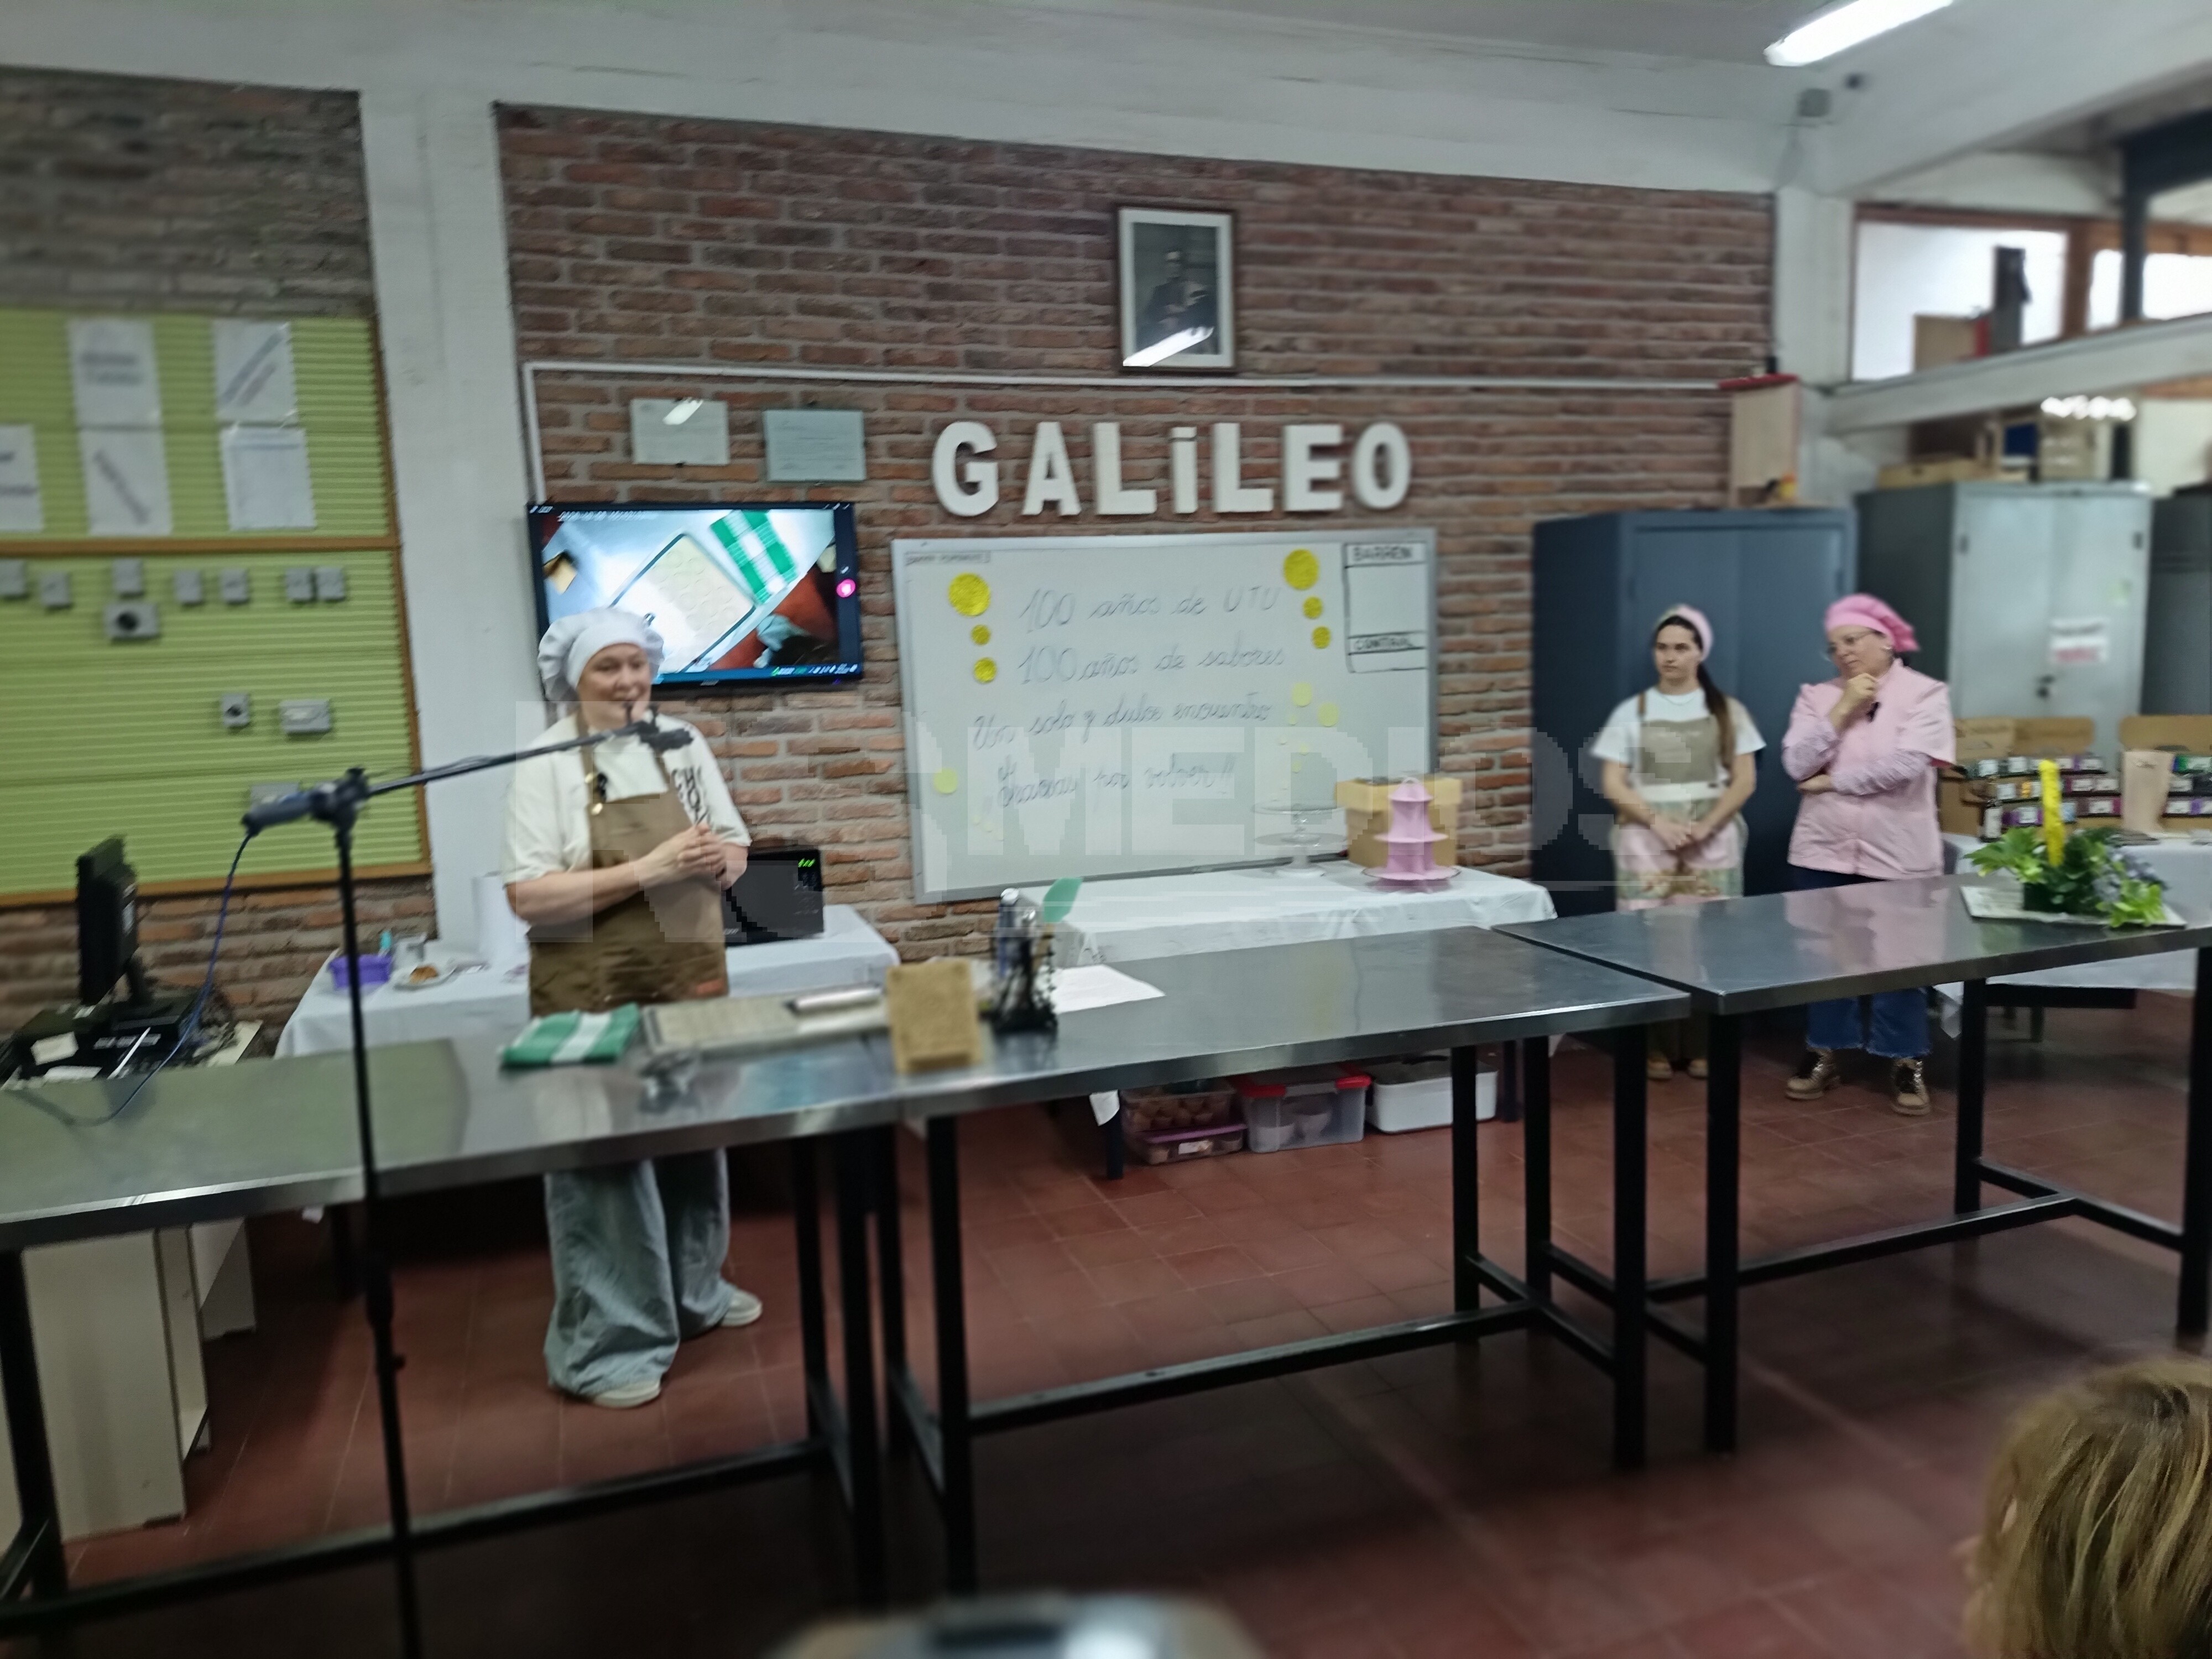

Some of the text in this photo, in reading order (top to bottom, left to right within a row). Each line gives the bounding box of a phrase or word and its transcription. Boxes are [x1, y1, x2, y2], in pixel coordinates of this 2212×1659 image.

[1018, 585, 1282, 634] 100 años de UTU
[1017, 629, 1286, 686] 100 años de sabores
[1082, 709, 1098, 744] y
